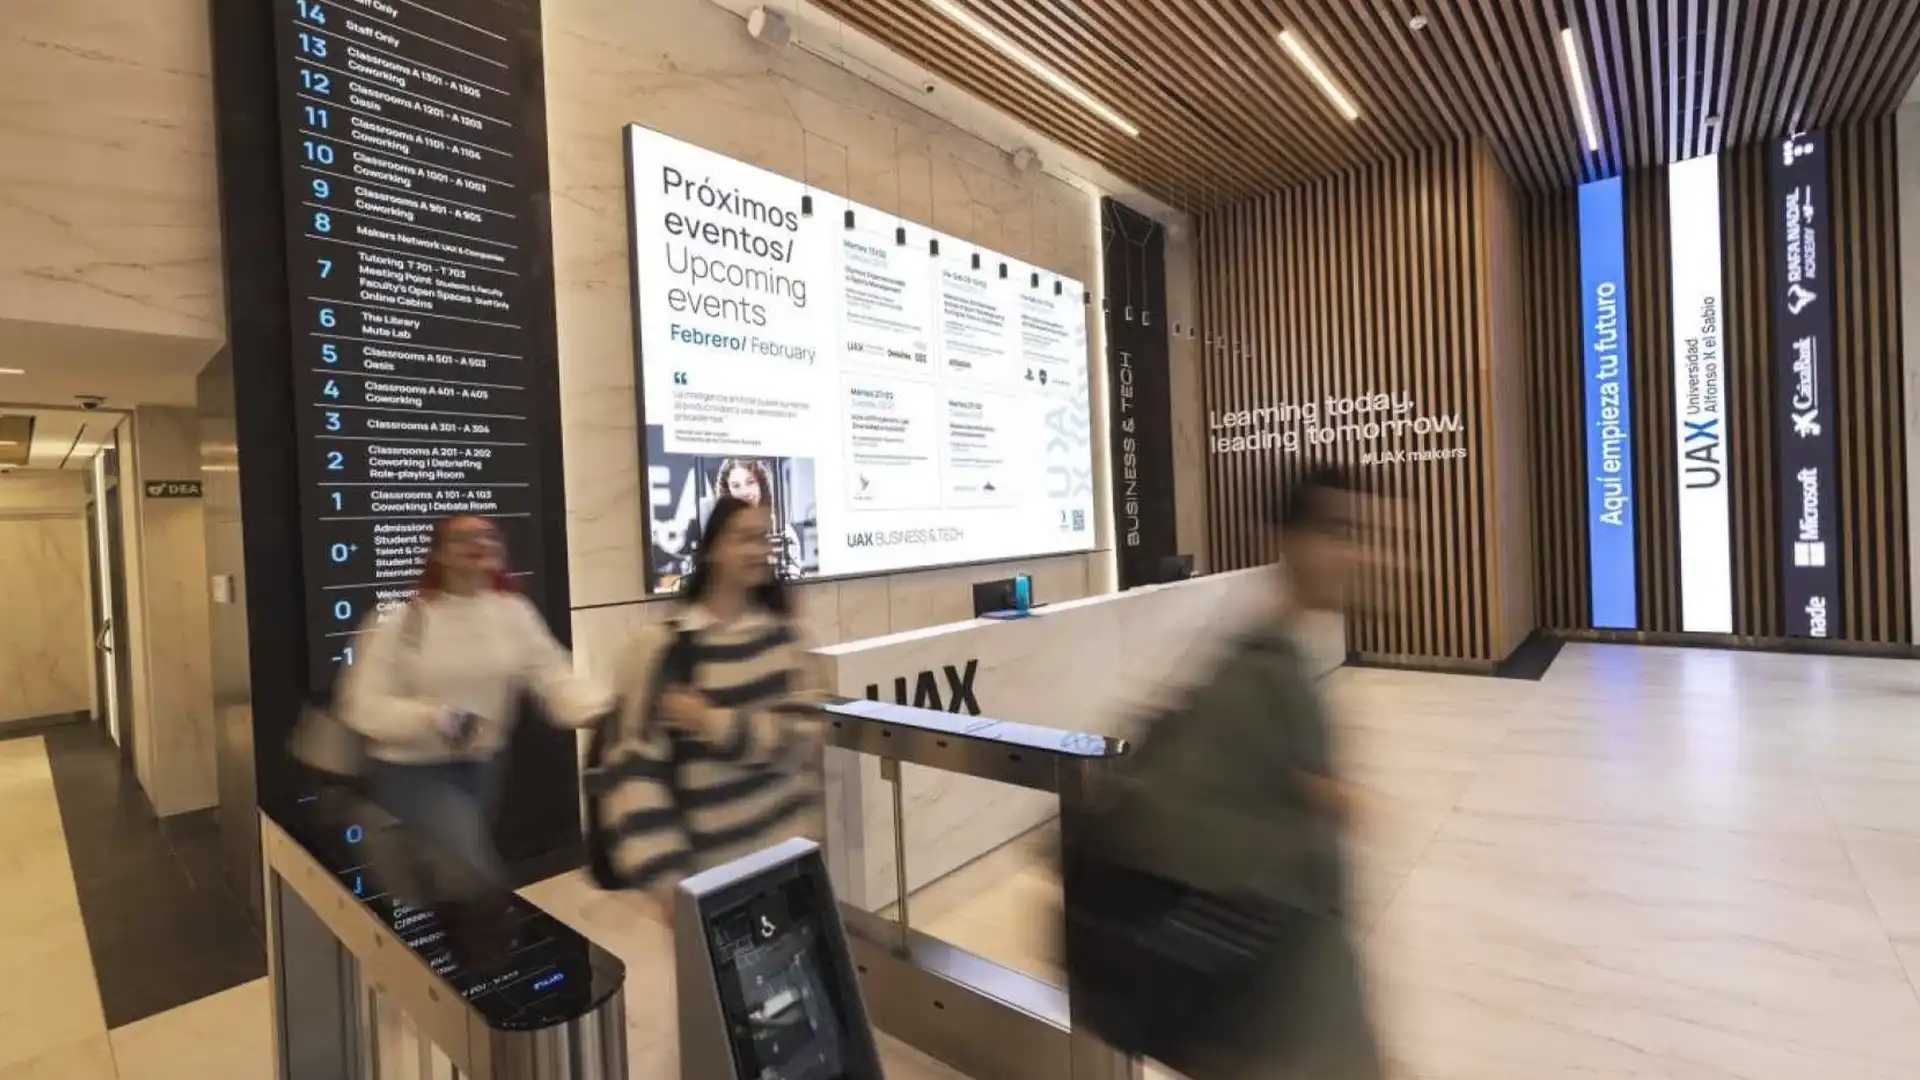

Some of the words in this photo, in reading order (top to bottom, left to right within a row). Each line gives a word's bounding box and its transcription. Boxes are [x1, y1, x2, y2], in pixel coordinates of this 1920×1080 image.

[298, 0, 326, 25] 14
[299, 33, 328, 58] 13
[346, 20, 373, 37] Staff
[374, 31, 400, 48] Only
[347, 47, 410, 75] Classrooms
[412, 69, 420, 78] A
[450, 81, 458, 91] A
[348, 60, 406, 87] Coworking
[300, 69, 330, 94] 12
[349, 82, 412, 109] Classrooms
[414, 102, 422, 111] A
[423, 105, 444, 118] 1201
[451, 113, 460, 122] A
[349, 94, 381, 111] Oasis
[305, 106, 328, 129] 11
[351, 117, 414, 141] Classrooms
[415, 135, 424, 144] A
[424, 137, 445, 150] 1101
[451, 145, 460, 154] A
[460, 148, 482, 160] 1104
[351, 130, 410, 155] Coworking
[304, 140, 334, 165] 10
[353, 152, 416, 175] Classrooms
[418, 168, 425, 177] A
[455, 178, 463, 187] A
[353, 164, 412, 188] Coworking
[312, 179, 329, 198] 9
[662, 166, 798, 232] Próximos
[354, 186, 418, 208] Classrooms
[420, 201, 428, 210] A
[454, 209, 462, 218] A
[355, 198, 414, 222] Coworking
[314, 212, 331, 232] 8
[356, 225, 396, 242] Makers
[398, 234, 440, 250] Network
[664, 211, 794, 263] eventos/
[318, 260, 332, 279] 7
[358, 251, 404, 270] Tutoring
[408, 260, 414, 269] T
[416, 262, 432, 273] 701
[440, 266, 448, 275] T
[358, 264, 404, 282] Meeting
[405, 272, 432, 284] Point
[666, 242, 806, 308] Upcoming
[359, 278, 406, 293] Faculty's
[408, 284, 435, 299] Open
[436, 290, 472, 303] Spaces
[360, 290, 396, 303] Online
[397, 295, 434, 309] Cabins
[320, 308, 336, 328] 6
[668, 288, 767, 326] events
[1594, 281, 1618, 352] futuro
[1700, 296, 1716, 333] Sabio
[362, 311, 382, 323] The
[384, 315, 420, 330] Library
[362, 324, 390, 337] Mute
[392, 328, 412, 339] Lab
[670, 323, 747, 352] Febrero/
[752, 336, 816, 364] February
[1702, 336, 1716, 348] el
[322, 344, 338, 364] 5
[362, 346, 425, 362] Classrooms
[427, 355, 435, 363] A
[436, 354, 453, 364] 501
[460, 358, 468, 366] A
[363, 359, 396, 371] Oasis
[1704, 350, 1716, 360] X
[1596, 354, 1618, 380] tu
[1684, 337, 1700, 416] Universidad
[324, 379, 340, 398] 4
[364, 380, 426, 395] Classrooms
[428, 386, 436, 395] A
[461, 390, 470, 398] A
[1120, 350, 1132, 411] TECH
[1704, 362, 1718, 414] Alfonso
[365, 393, 422, 408] Coworking
[1210, 400, 1317, 430] Learning
[1325, 389, 1415, 416] today,
[326, 412, 340, 432] 3
[367, 418, 430, 431] Classrooms
[430, 422, 438, 432] A
[463, 424, 471, 432] A
[1122, 418, 1136, 433] &
[1211, 430, 1300, 455] leading
[1306, 412, 1465, 445] tomorrow.
[1597, 381, 1628, 472] empieza
[327, 452, 344, 470] 2
[368, 444, 430, 456] Classrooms
[432, 448, 440, 456] A
[441, 448, 458, 456] 201
[464, 448, 472, 457] A
[1684, 418, 1721, 488] UAX
[368, 456, 426, 470] Coworking
[432, 458, 482, 470] Debriefing
[369, 468, 435, 481] Role-playing
[436, 470, 466, 479] Room
[168, 484, 199, 495] DEA
[371, 490, 433, 500] Classrooms
[436, 490, 444, 500] A
[445, 490, 460, 500] 101
[466, 490, 474, 500] A
[1122, 436, 1140, 548] BUSINESS
[332, 492, 342, 512] 1
[372, 502, 428, 513] Coworking
[434, 501, 469, 511] Debate
[470, 501, 498, 511] Room
[1596, 477, 1628, 526] Aquí
[1797, 468, 1819, 540] Microsoft
[374, 524, 434, 532] Admissions
[876, 528, 927, 546] BUSINESS
[937, 528, 964, 542] TECH
[374, 535, 418, 545] Student
[375, 547, 404, 556] Talent
[334, 600, 351, 620] 0
[332, 646, 354, 665] -1
